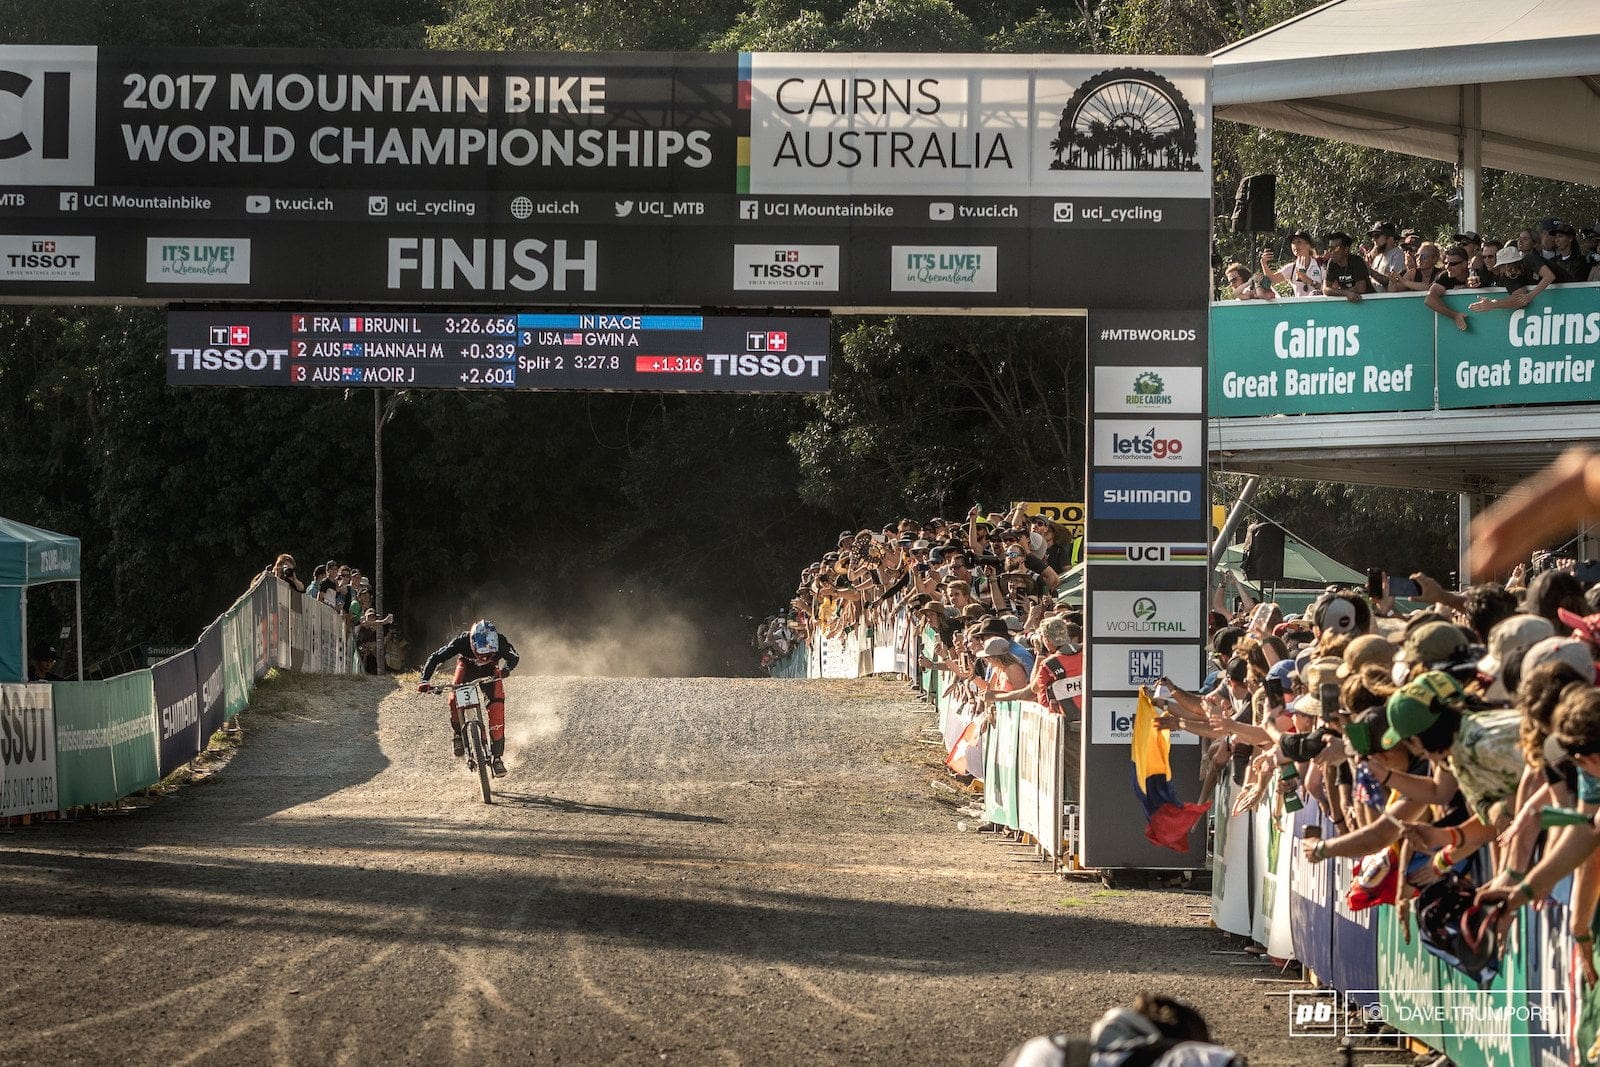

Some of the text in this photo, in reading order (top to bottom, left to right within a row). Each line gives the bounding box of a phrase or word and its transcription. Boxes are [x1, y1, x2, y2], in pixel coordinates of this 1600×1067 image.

[123, 73, 606, 114] 2017 MOUNTAIN BIKE
[775, 77, 942, 117] CAIRNS
[121, 123, 712, 168] WORLD CHAMPIONSHIPS
[773, 130, 1013, 170] AUSTRALIA
[84, 195, 212, 210] UCI Mountainbike
[275, 197, 334, 212] tv.uci.ch
[396, 199, 476, 216] uci_cycling
[537, 200, 580, 215] uci.ch
[638, 201, 705, 218] UCI_MTB
[764, 203, 894, 218] UCI Mountainbike
[959, 204, 1018, 218] tv.uci.ch
[1082, 206, 1163, 222] uci_cycling
[7, 254, 80, 268] TISSOT
[162, 245, 235, 261] IT'S LIVE!
[907, 253, 981, 270] IT'S LIVE!
[162, 258, 231, 275] in Queensland
[387, 237, 597, 292] FINISH
[749, 264, 824, 278] TISSOT
[908, 266, 977, 284] in Queensland
[298, 317, 516, 334] 1 FRA BRUNI L 3:26.656
[579, 315, 641, 330] IN RACE
[523, 332, 639, 347] 3 USA GWIN A
[1100, 329, 1196, 341] #MTBWORLDS
[1273, 319, 1360, 360] Cairns
[297, 342, 515, 359] 2 AUS HANNAH M +0.339
[170, 348, 289, 371] TISSOT
[518, 355, 703, 373] Split 2 3:27.8 +1.316
[706, 354, 827, 377] TISSOT
[297, 366, 515, 384] 3 AUS MOIR J +2.601
[1456, 354, 1595, 389] Great Barrier
[1222, 363, 1414, 399] Great Barrier Reef
[1126, 395, 1172, 405] RIDE CAIRNS
[1113, 432, 1183, 459] letsgo
[1103, 489, 1192, 504] SHIMANO
[1128, 546, 1165, 562] UCI
[1106, 621, 1187, 632] WORLDTRAIL
[1131, 652, 1161, 676] SMS
[463, 690, 471, 701] 3
[163, 691, 198, 740] SHIMANO
[1111, 711, 1137, 732] let
